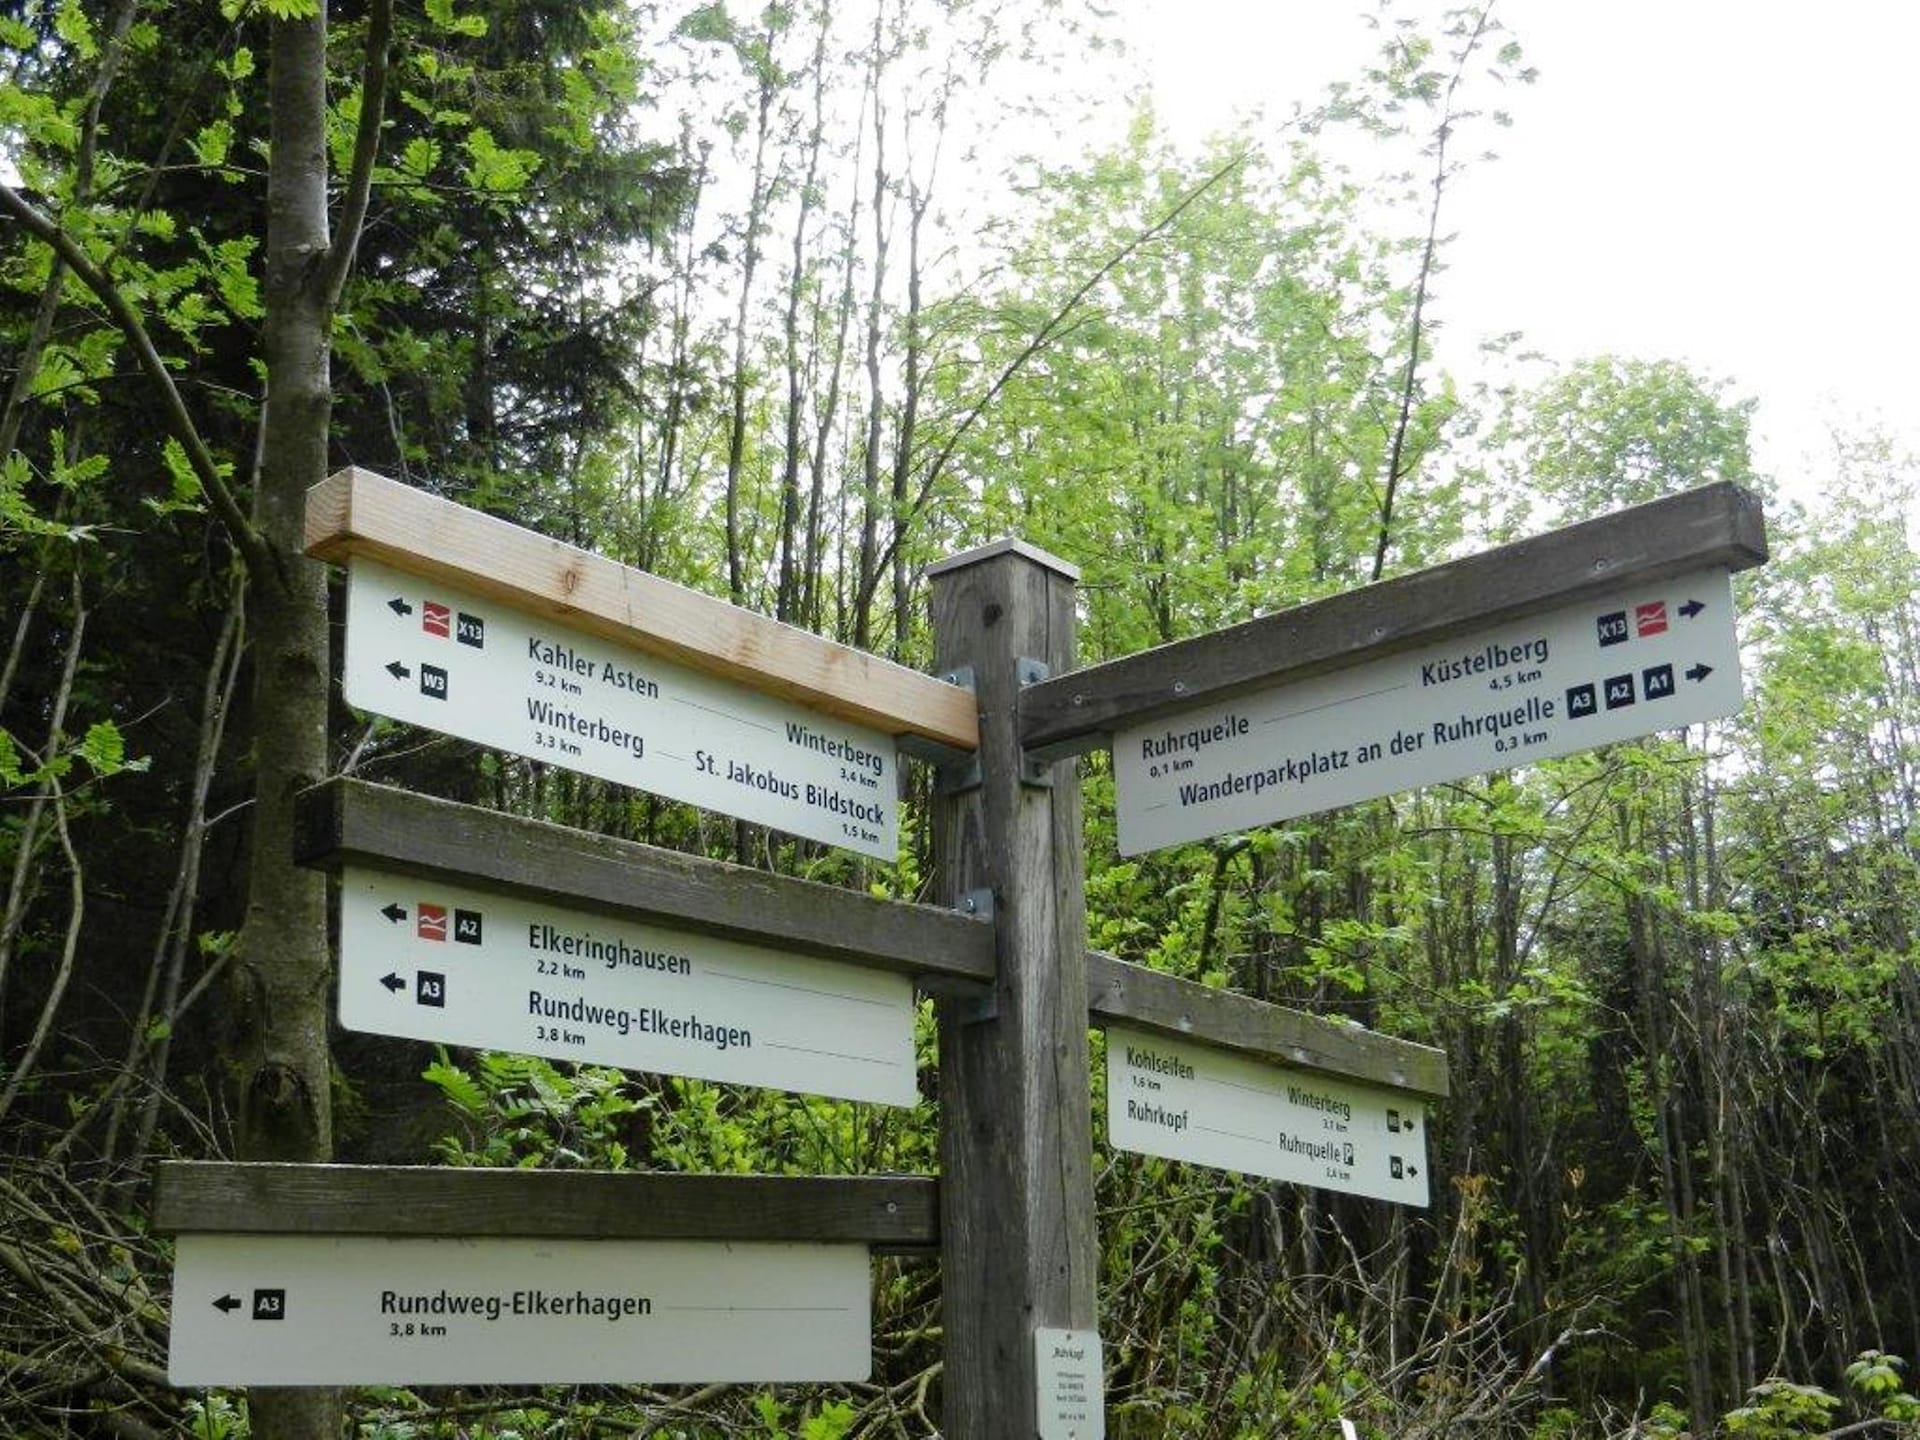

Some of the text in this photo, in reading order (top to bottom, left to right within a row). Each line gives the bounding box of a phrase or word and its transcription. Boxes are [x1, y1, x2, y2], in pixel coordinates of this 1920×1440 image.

[458, 621, 482, 640] X13
[1600, 619, 1626, 641] X13
[528, 637, 659, 699] Kahler Asten
[1421, 637, 1549, 687] Küstelberg
[422, 671, 445, 691] W3
[535, 670, 582, 695] 9,2 km
[1489, 669, 1542, 690] 4,5 km
[1572, 673, 1668, 711] A3 A2 A1
[527, 697, 644, 758] Winterberg
[1142, 714, 1249, 760] Ruhrquelle
[535, 731, 582, 756] 3,3 km
[786, 722, 883, 777] Winterberg
[1179, 696, 1555, 807] Wanderparkplatz an der Ruhrquelle
[1494, 730, 1548, 752] 0,3 km
[859, 772, 878, 789] km
[1149, 759, 1193, 778] 0,1 km
[696, 750, 884, 826] St. Jakobus Bildstock
[861, 829, 880, 844] km
[459, 919, 477, 936] A2
[529, 924, 692, 976] Elkeringhausen
[537, 960, 586, 980] 2,2 km
[421, 980, 441, 998] A3
[529, 990, 752, 1050] Rundweg-Elkerhagen
[537, 1026, 586, 1046] 3,8 km
[1127, 1045, 1195, 1081] Kohlseifen
[1127, 1099, 1188, 1133] Ruhrkopf
[1287, 1085, 1351, 1122] Winterberg
[1279, 1132, 1341, 1162] Ruhrquelle
[256, 1298, 280, 1313] A3
[381, 1290, 651, 1320] Rundweg-Elkerhagen
[389, 1322, 447, 1337] 3,8 km
